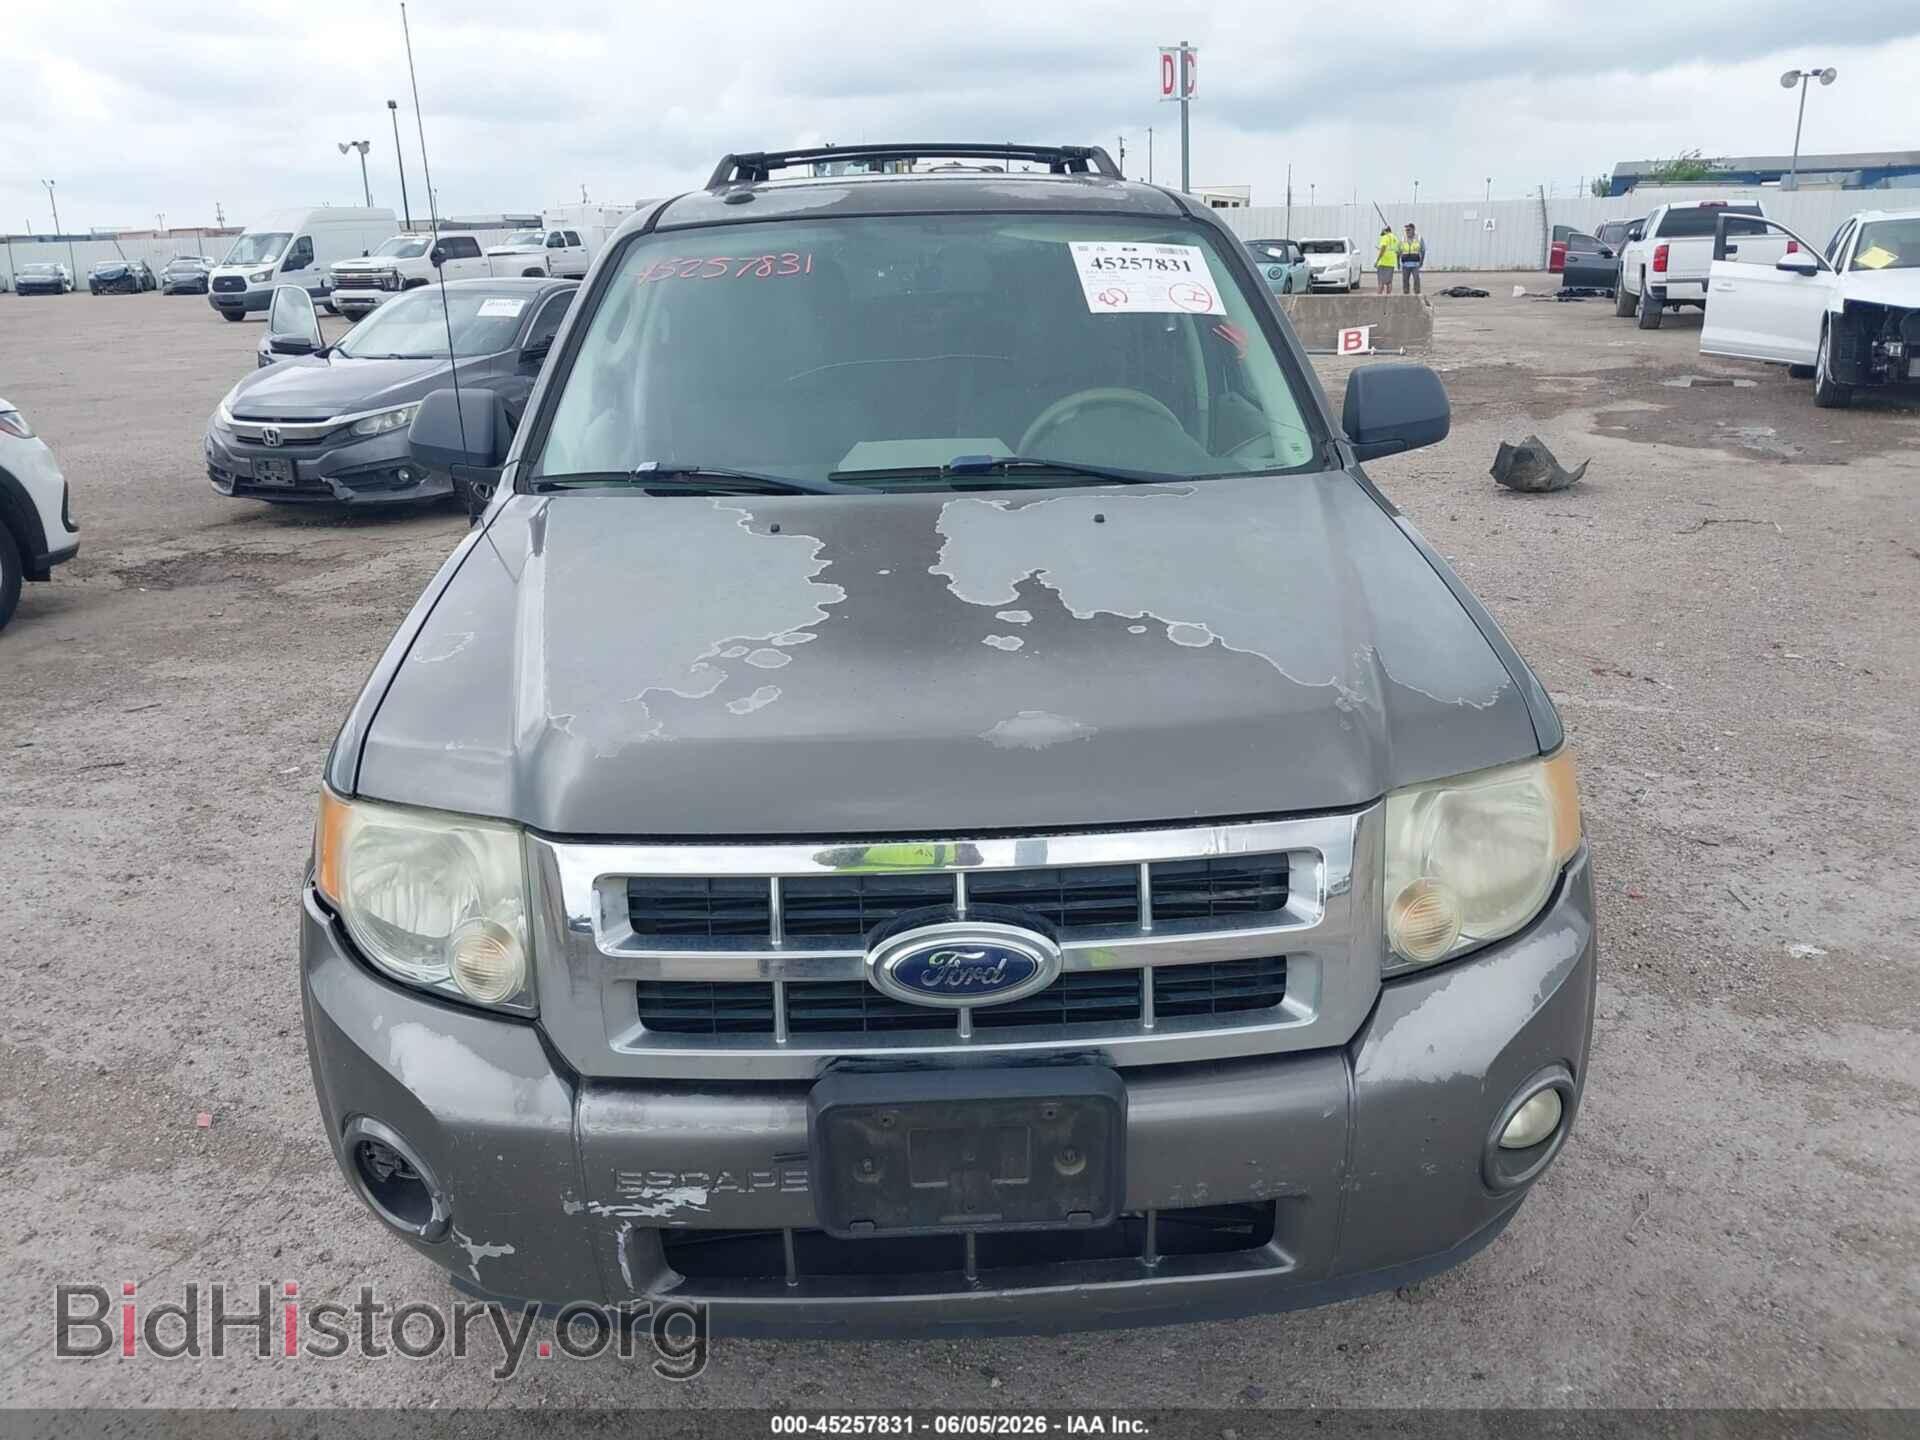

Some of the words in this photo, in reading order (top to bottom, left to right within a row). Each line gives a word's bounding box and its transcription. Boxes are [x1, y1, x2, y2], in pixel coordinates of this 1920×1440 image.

[1162, 54, 1174, 95] D
[634, 252, 813, 286] 45257831
[1090, 256, 1192, 273] 45257831
[1343, 330, 1362, 352] B
[920, 950, 1008, 987] Ford
[615, 1170, 809, 1193] ESCAPE
